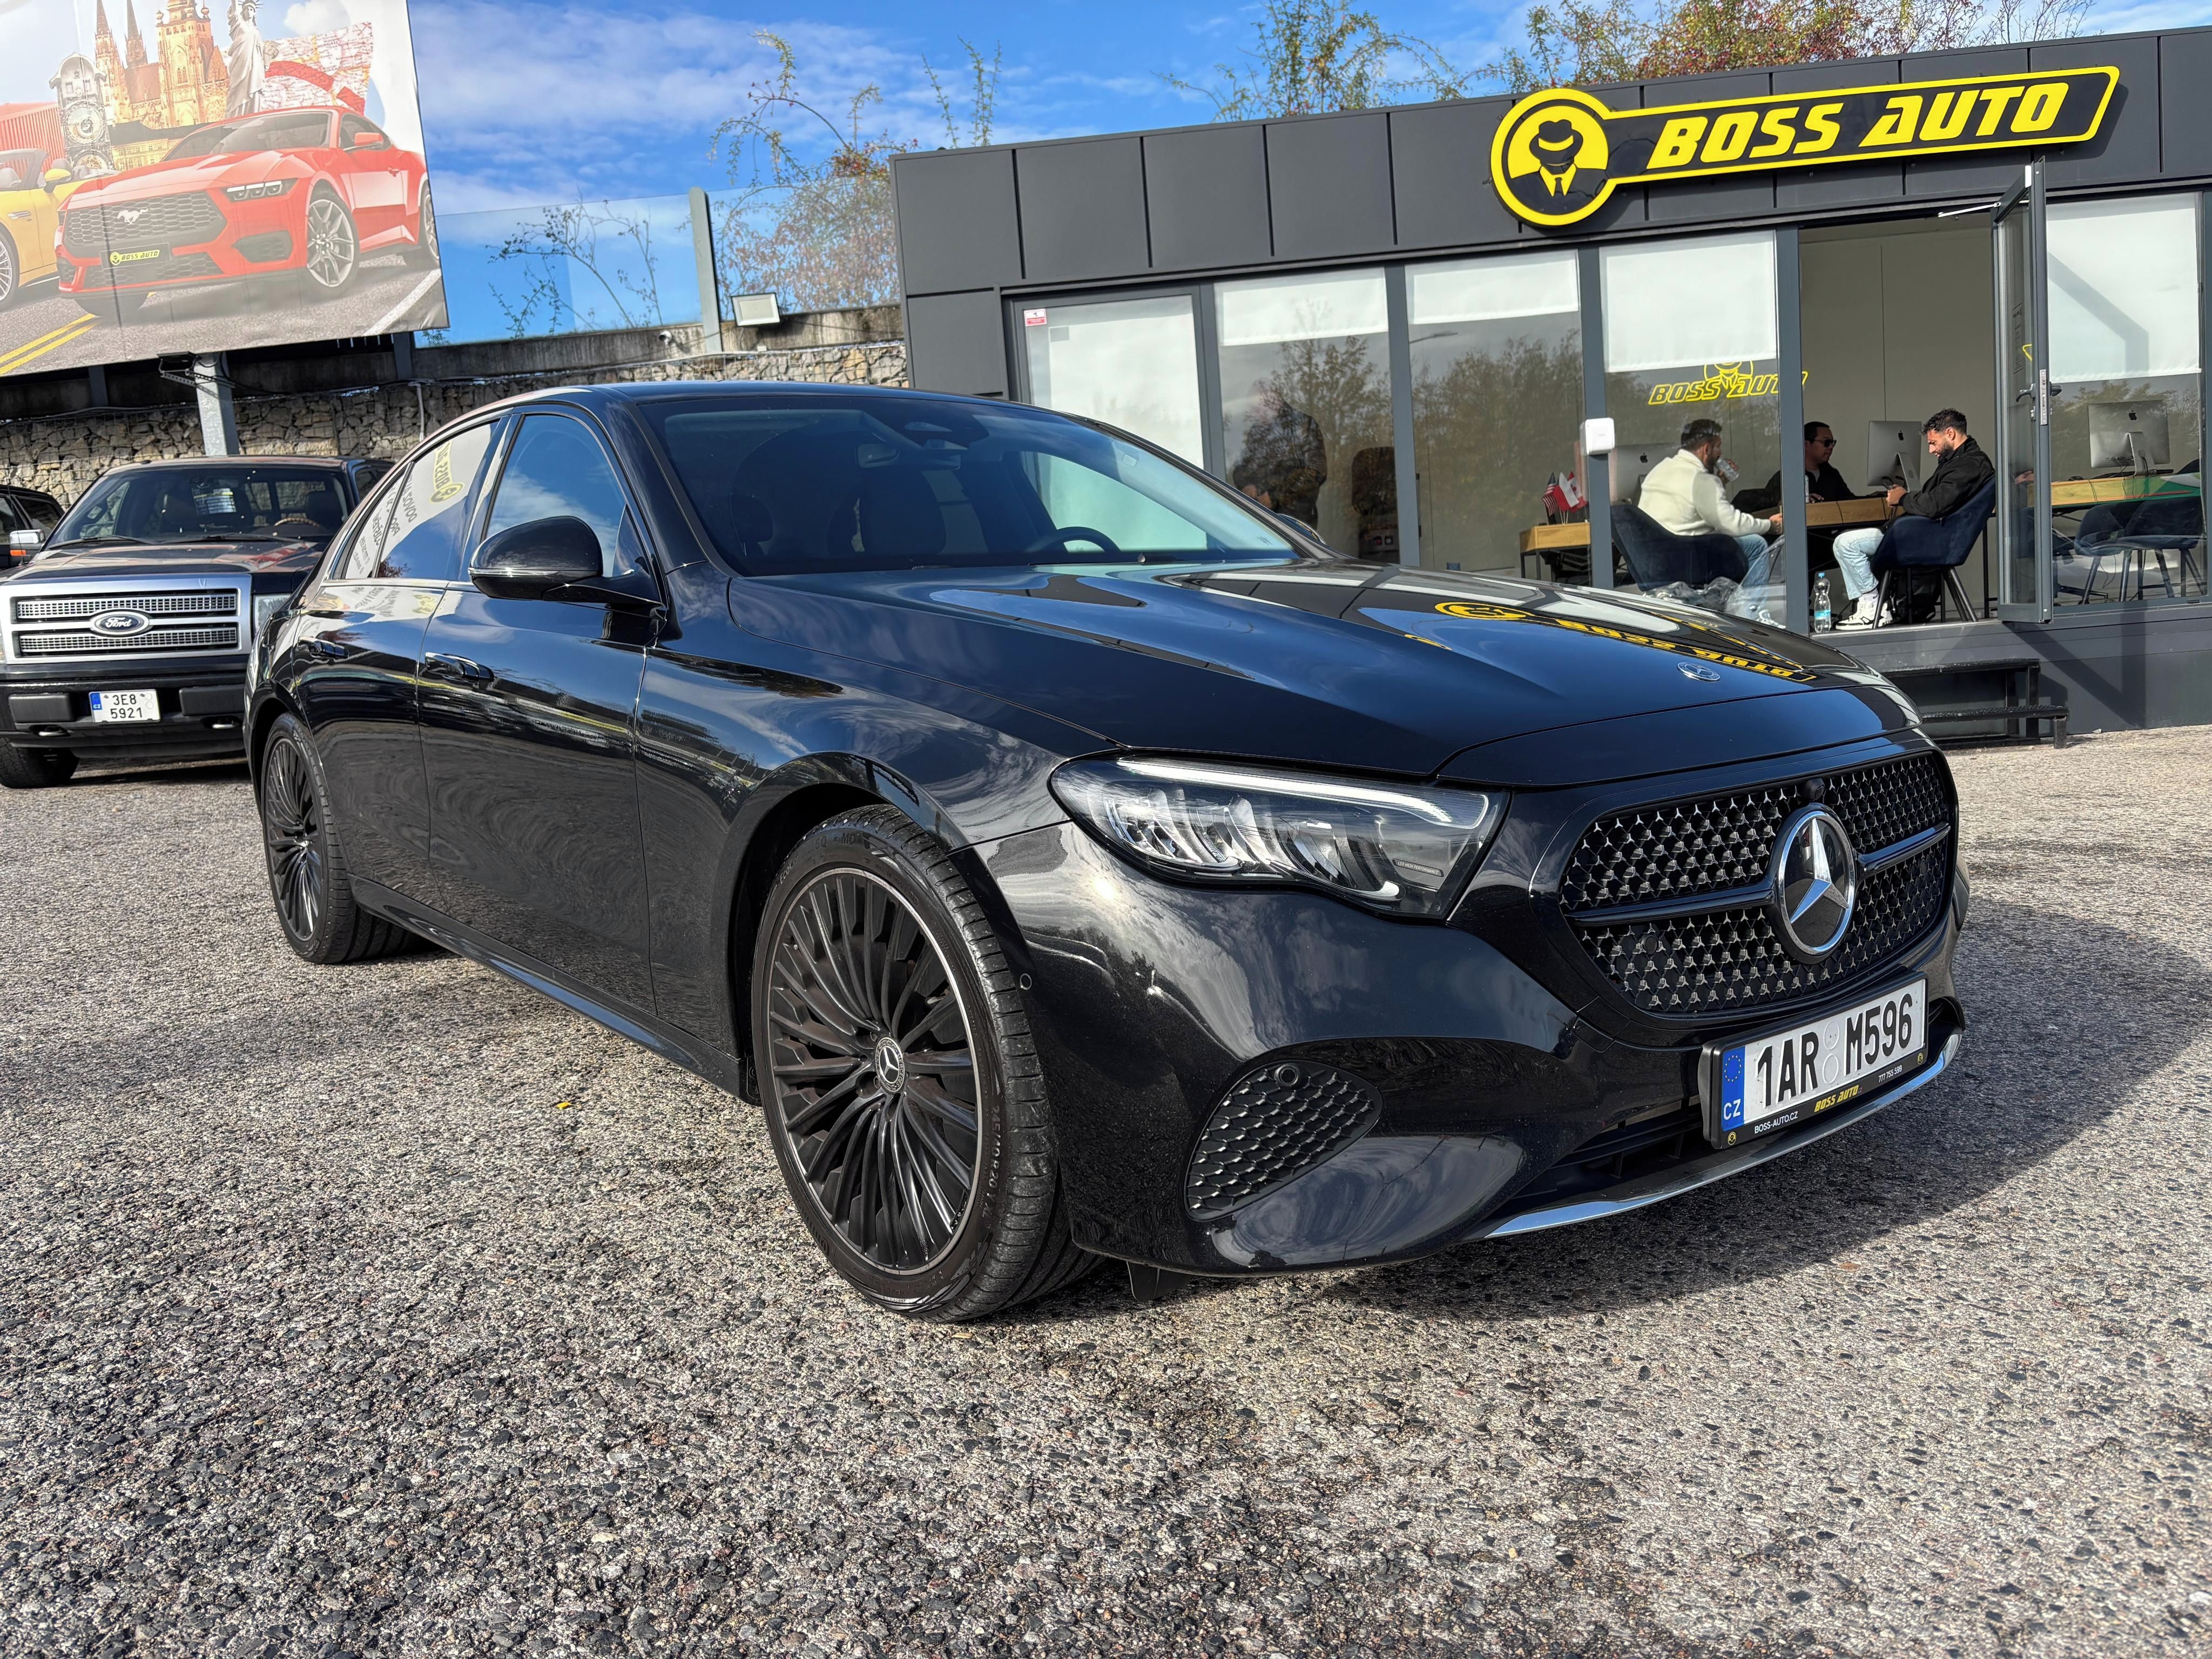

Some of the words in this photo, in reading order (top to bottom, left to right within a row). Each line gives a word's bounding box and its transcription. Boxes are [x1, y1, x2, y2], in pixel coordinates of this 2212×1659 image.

[1647, 103, 1843, 169] BOSS
[1858, 82, 2069, 147] AUTO
[1648, 379, 1721, 405] BOSS
[105, 617, 132, 628] Ford
[112, 693, 137, 705] 3E8
[110, 707, 143, 719] 5921
[1414, 865, 1439, 874] PERFORMANCE
[1756, 1031, 1819, 1108] 1AR
[1846, 993, 1912, 1075] M596
[1886, 1069, 1894, 1078] 755
[1894, 1064, 1902, 1074] 599
[1723, 1098, 1741, 1120] CZ
[1814, 1094, 1836, 1112] BOSS
[1837, 1084, 1859, 1103] AUTO
[1755, 1111, 1798, 1134] BOSS-AUTO.CZ
